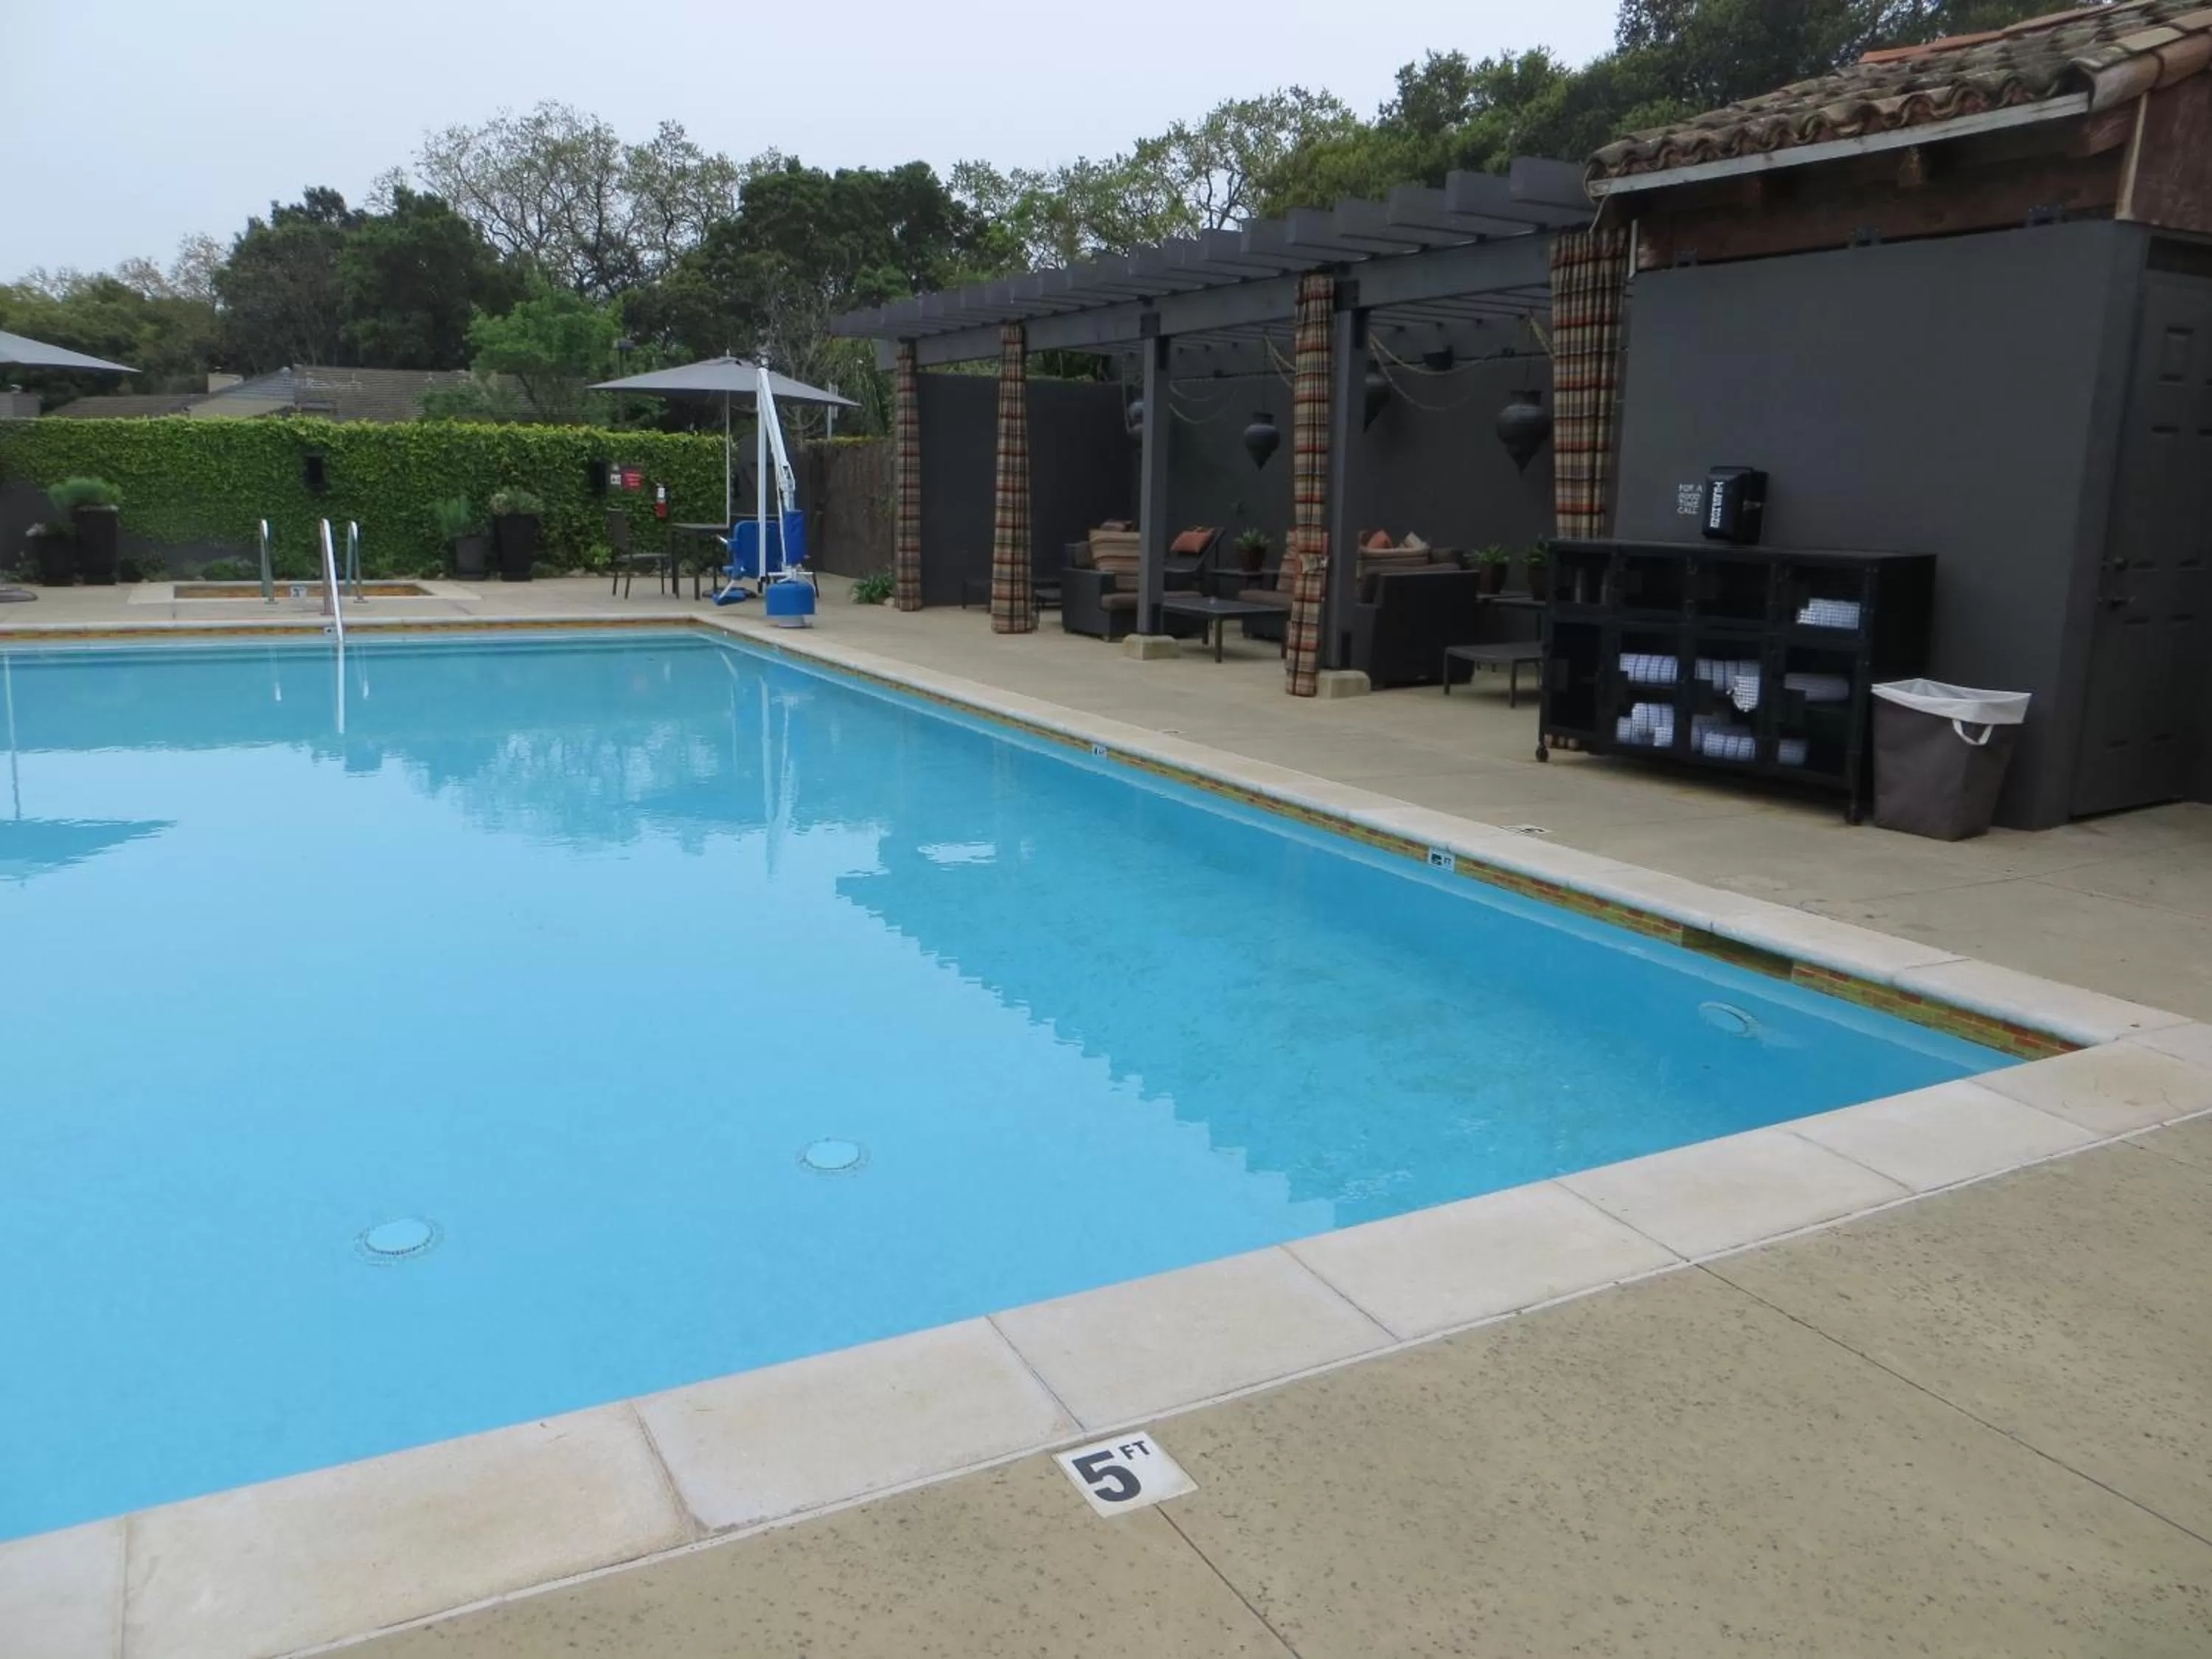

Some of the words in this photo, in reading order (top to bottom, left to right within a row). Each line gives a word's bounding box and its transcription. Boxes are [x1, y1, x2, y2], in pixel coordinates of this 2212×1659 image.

[1678, 484, 1694, 493] FOR
[1695, 484, 1703, 493] A
[1677, 507, 1700, 515] CALL
[1071, 1450, 1141, 1502] 5
[1119, 1440, 1150, 1461] FT
